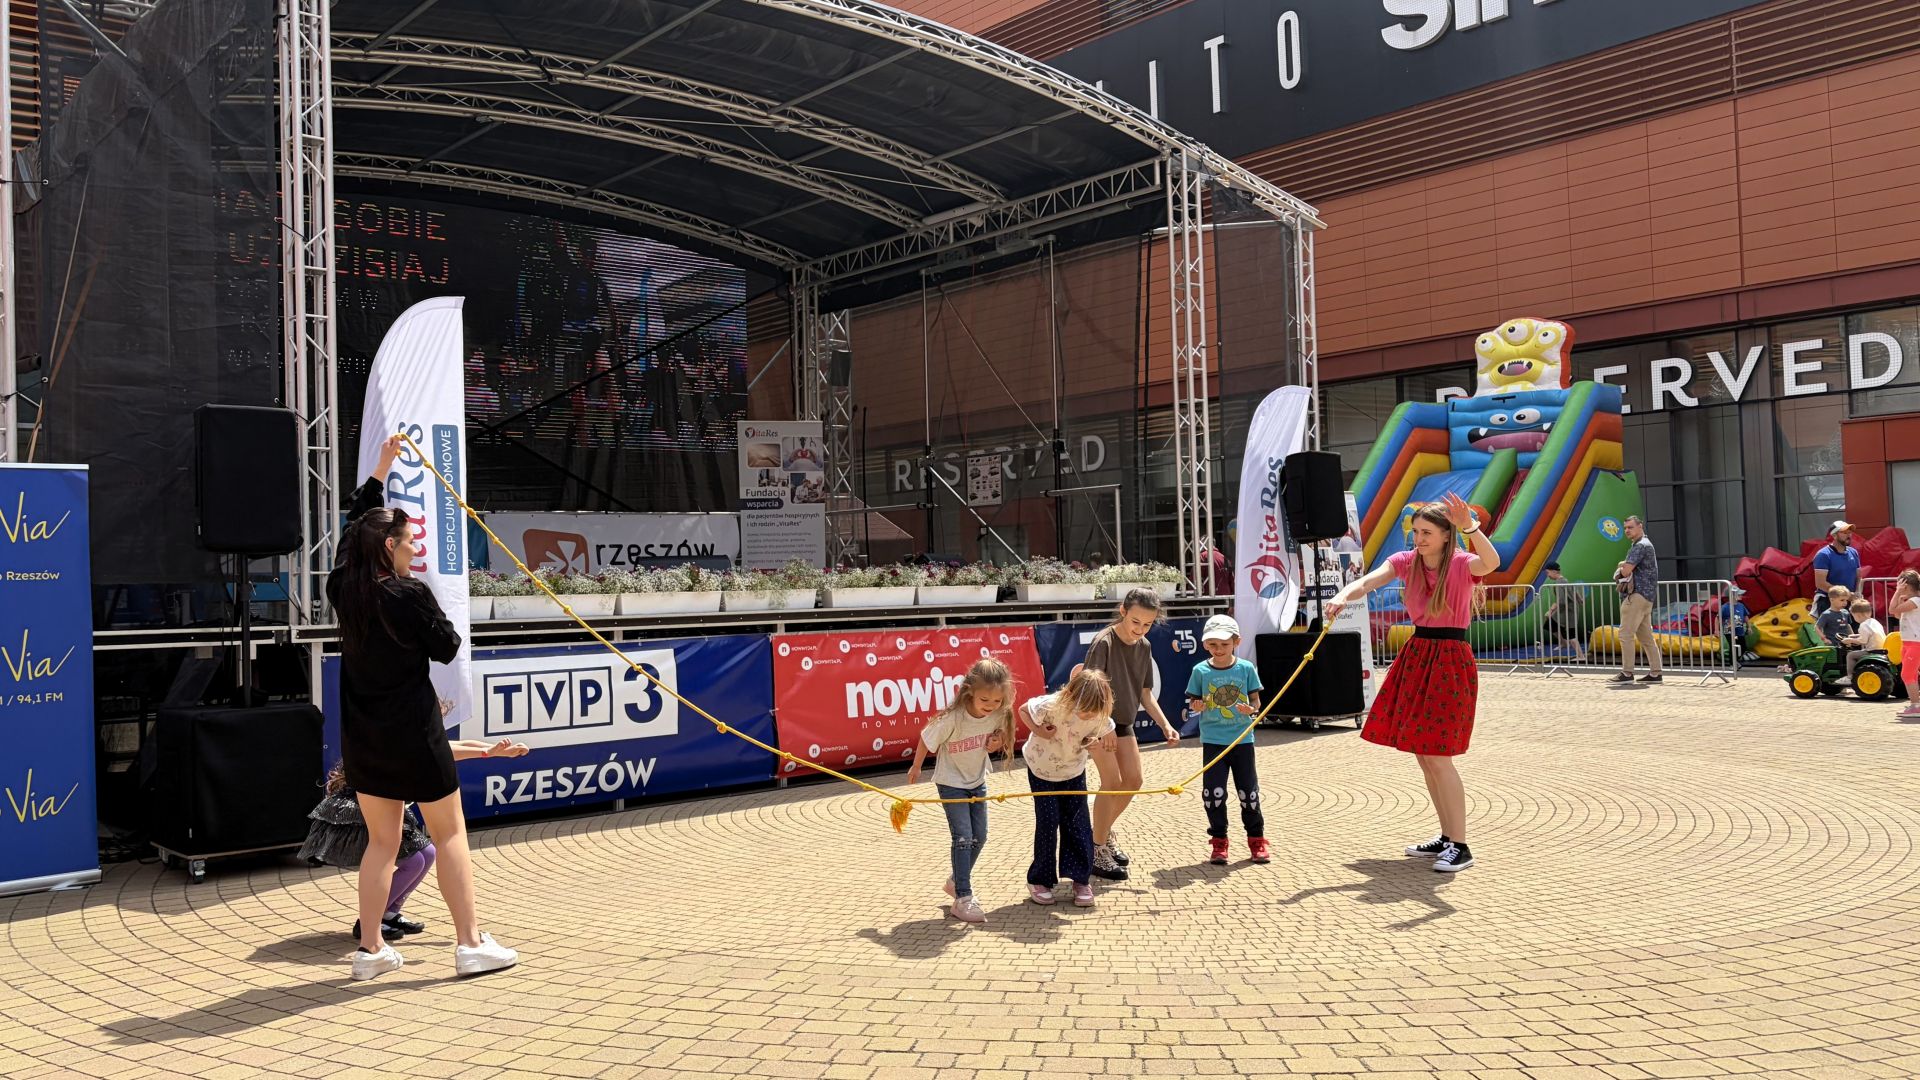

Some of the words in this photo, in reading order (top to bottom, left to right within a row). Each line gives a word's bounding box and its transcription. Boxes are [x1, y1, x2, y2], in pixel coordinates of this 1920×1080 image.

[1096, 11, 1302, 119] ITO
[745, 488, 786, 499] Fundacja
[746, 500, 779, 508] wsparcia
[444, 496, 457, 571] HOSPICJUM
[6, 569, 60, 581] Rzeszów
[1, 629, 75, 682] Via
[1174, 630, 1197, 655] 75
[16, 693, 42, 705] 94,1
[45, 691, 64, 703] FM
[491, 677, 604, 726] TVP
[623, 662, 664, 724] 3
[845, 667, 965, 718] nowin
[5, 768, 79, 822] Via
[485, 753, 657, 807] RZESZÓW
